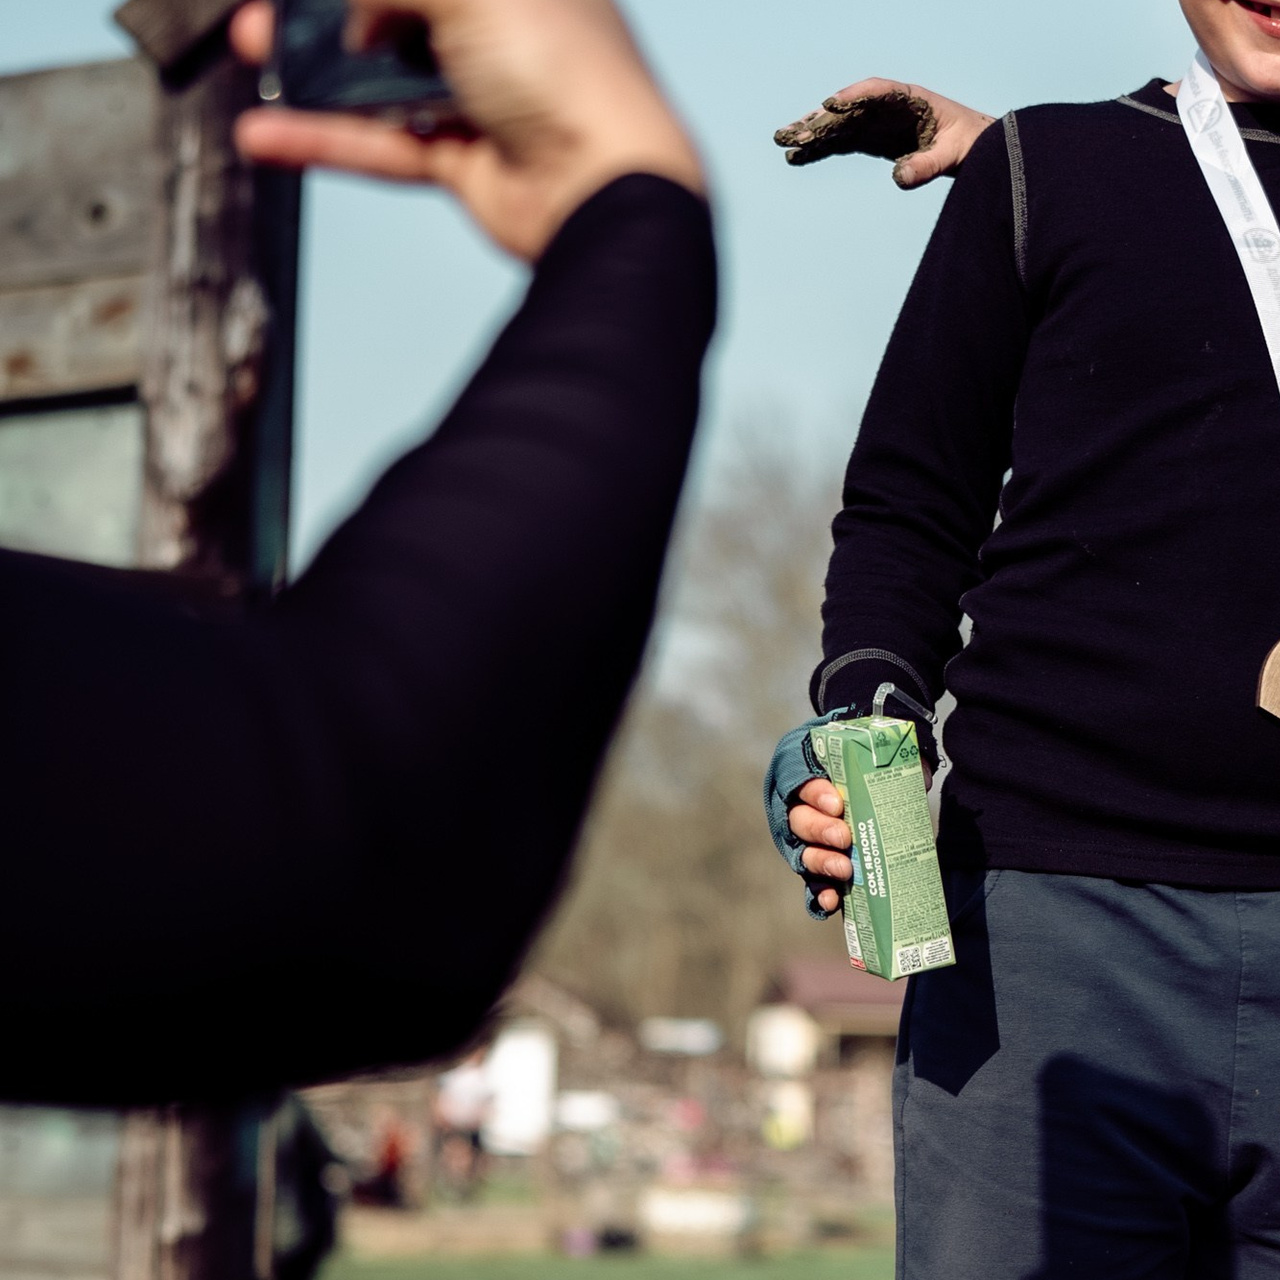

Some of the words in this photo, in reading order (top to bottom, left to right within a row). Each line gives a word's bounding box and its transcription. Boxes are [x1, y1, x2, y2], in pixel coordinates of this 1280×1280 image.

[858, 821, 874, 870] ЯБЛОКО
[866, 818, 880, 857] ОТЖИМА
[866, 871, 878, 897] СОК
[873, 856, 887, 898] ПРЯМОГО
